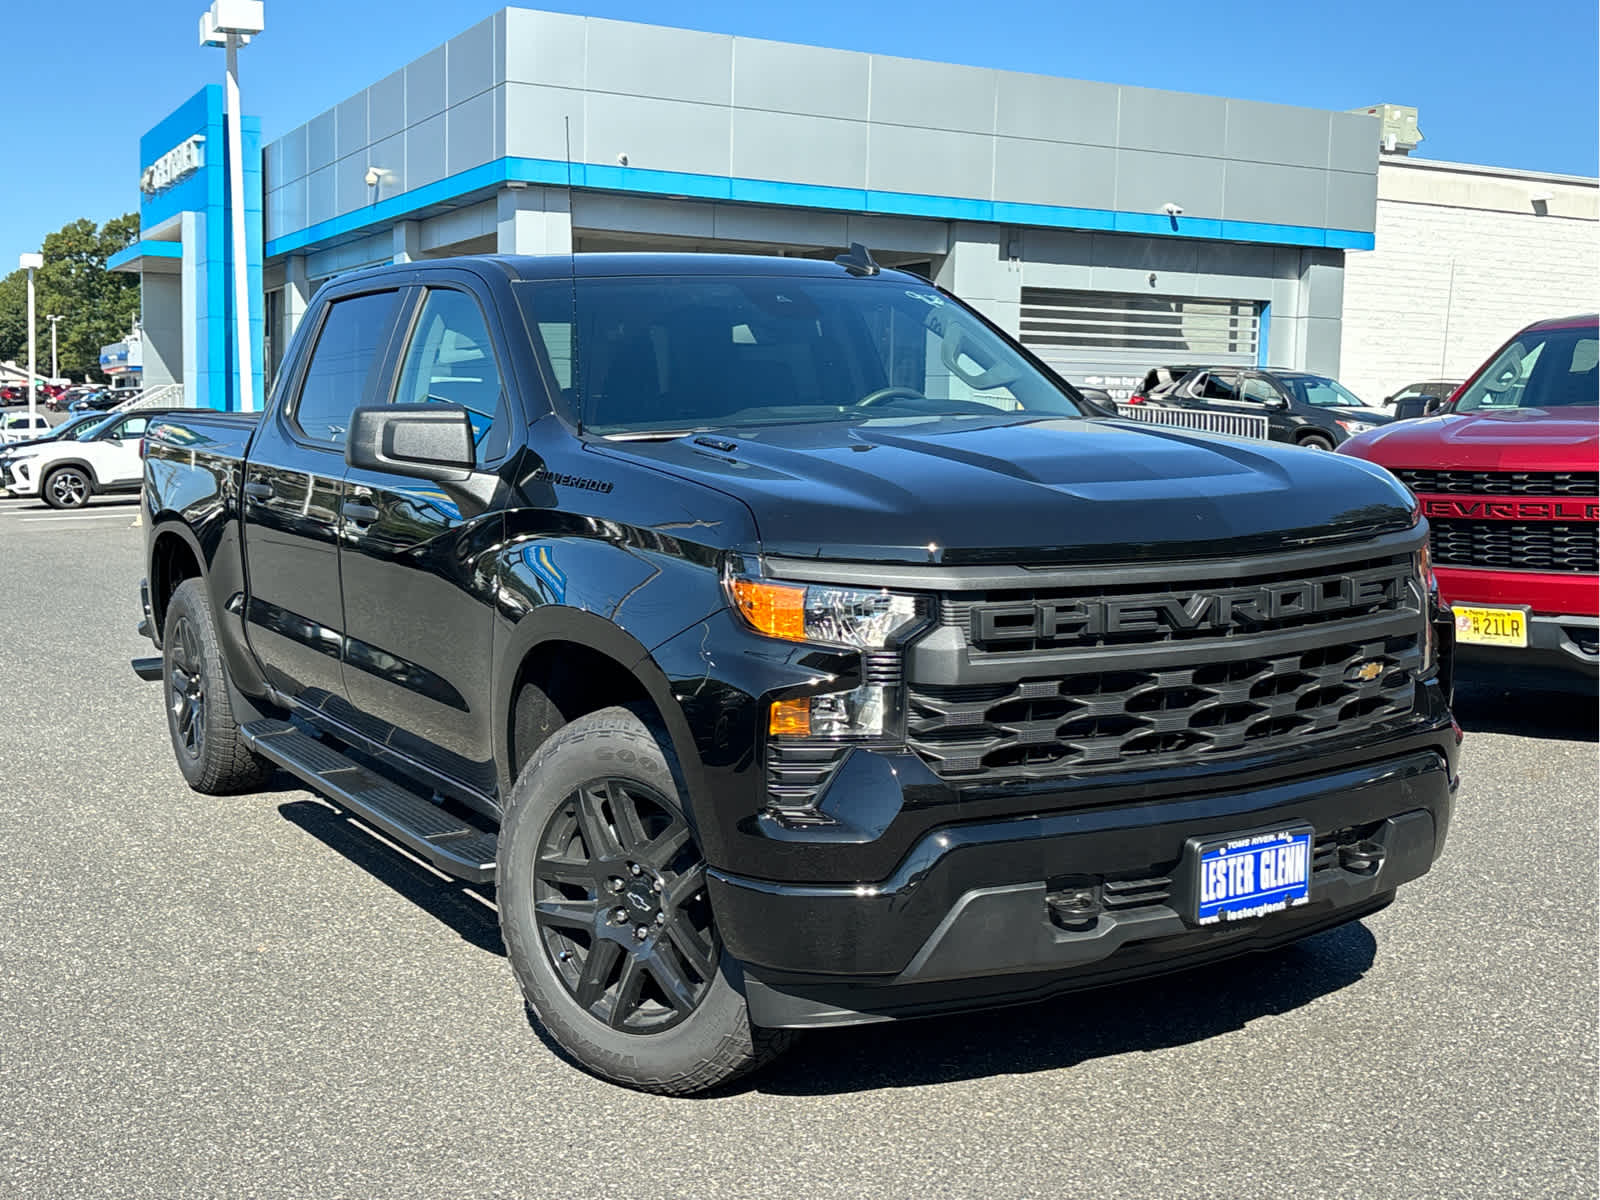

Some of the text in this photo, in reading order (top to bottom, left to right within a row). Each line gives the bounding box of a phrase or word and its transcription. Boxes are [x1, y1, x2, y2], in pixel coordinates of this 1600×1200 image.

[534, 470, 614, 494] SILVERADO
[970, 570, 1410, 641] CHEVROLET
[1483, 617, 1520, 638] 21LR
[1201, 844, 1306, 903] LESTER GLENN
